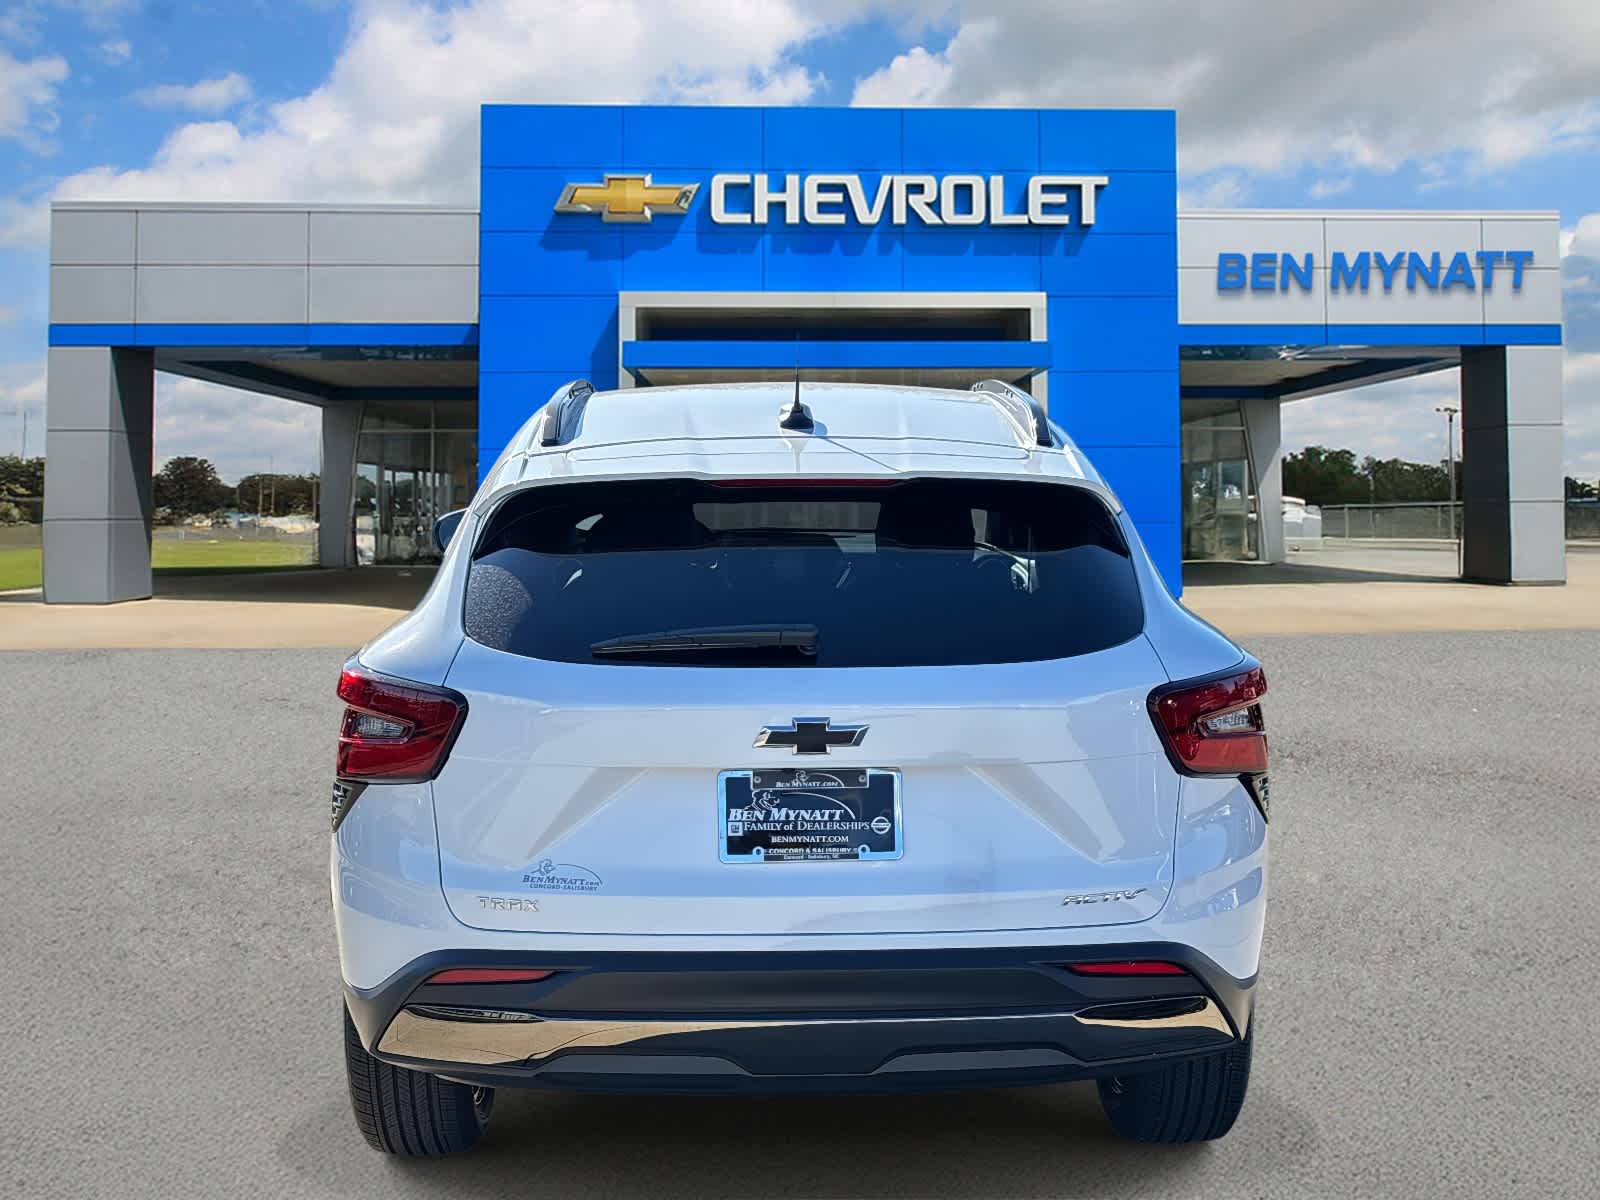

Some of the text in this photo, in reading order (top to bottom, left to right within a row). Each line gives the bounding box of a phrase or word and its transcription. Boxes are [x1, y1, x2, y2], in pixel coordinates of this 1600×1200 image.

[711, 174, 1109, 226] CHEVROLET
[1217, 250, 1534, 291] BEN MYNATT
[728, 807, 844, 822] BEN MYNATT
[744, 821, 783, 831] FAMILY
[784, 821, 794, 831] of
[797, 820, 870, 831] DEALERSHIPS
[771, 835, 849, 843] BENMYNATT.COM
[477, 896, 541, 912] TRAX
[1062, 888, 1147, 906] ACTIV
